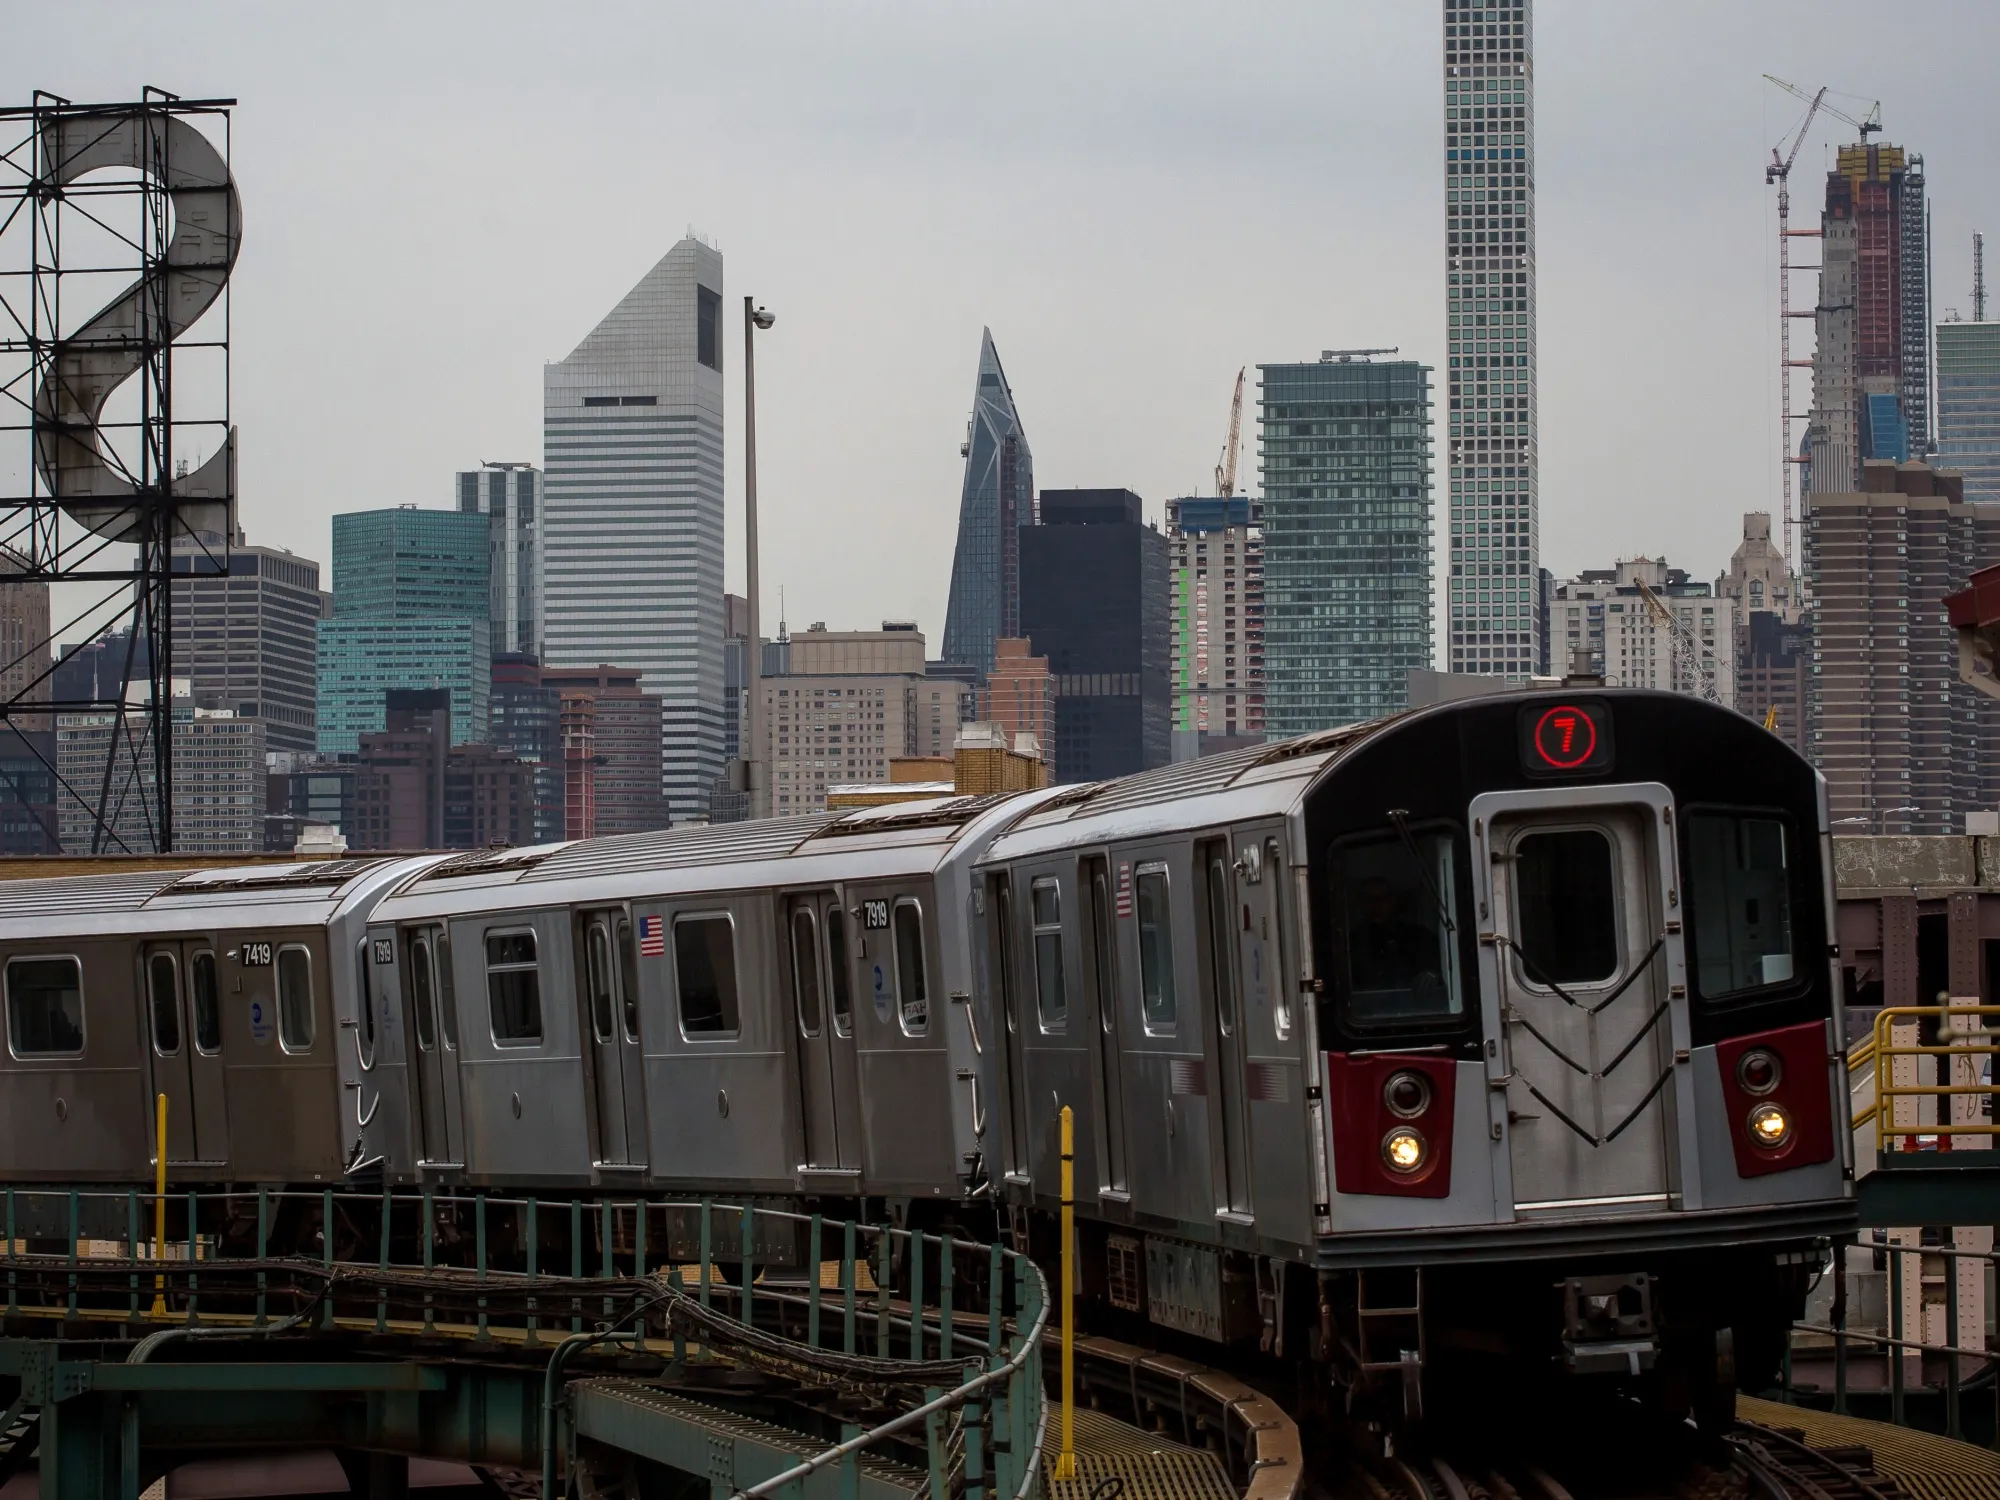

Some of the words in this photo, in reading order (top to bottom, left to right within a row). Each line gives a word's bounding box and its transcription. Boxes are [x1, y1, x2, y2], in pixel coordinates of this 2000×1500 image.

[1553, 716, 1575, 752] 7
[864, 900, 887, 927] 7919
[242, 943, 271, 965] 7419
[375, 940, 392, 963] 7919
